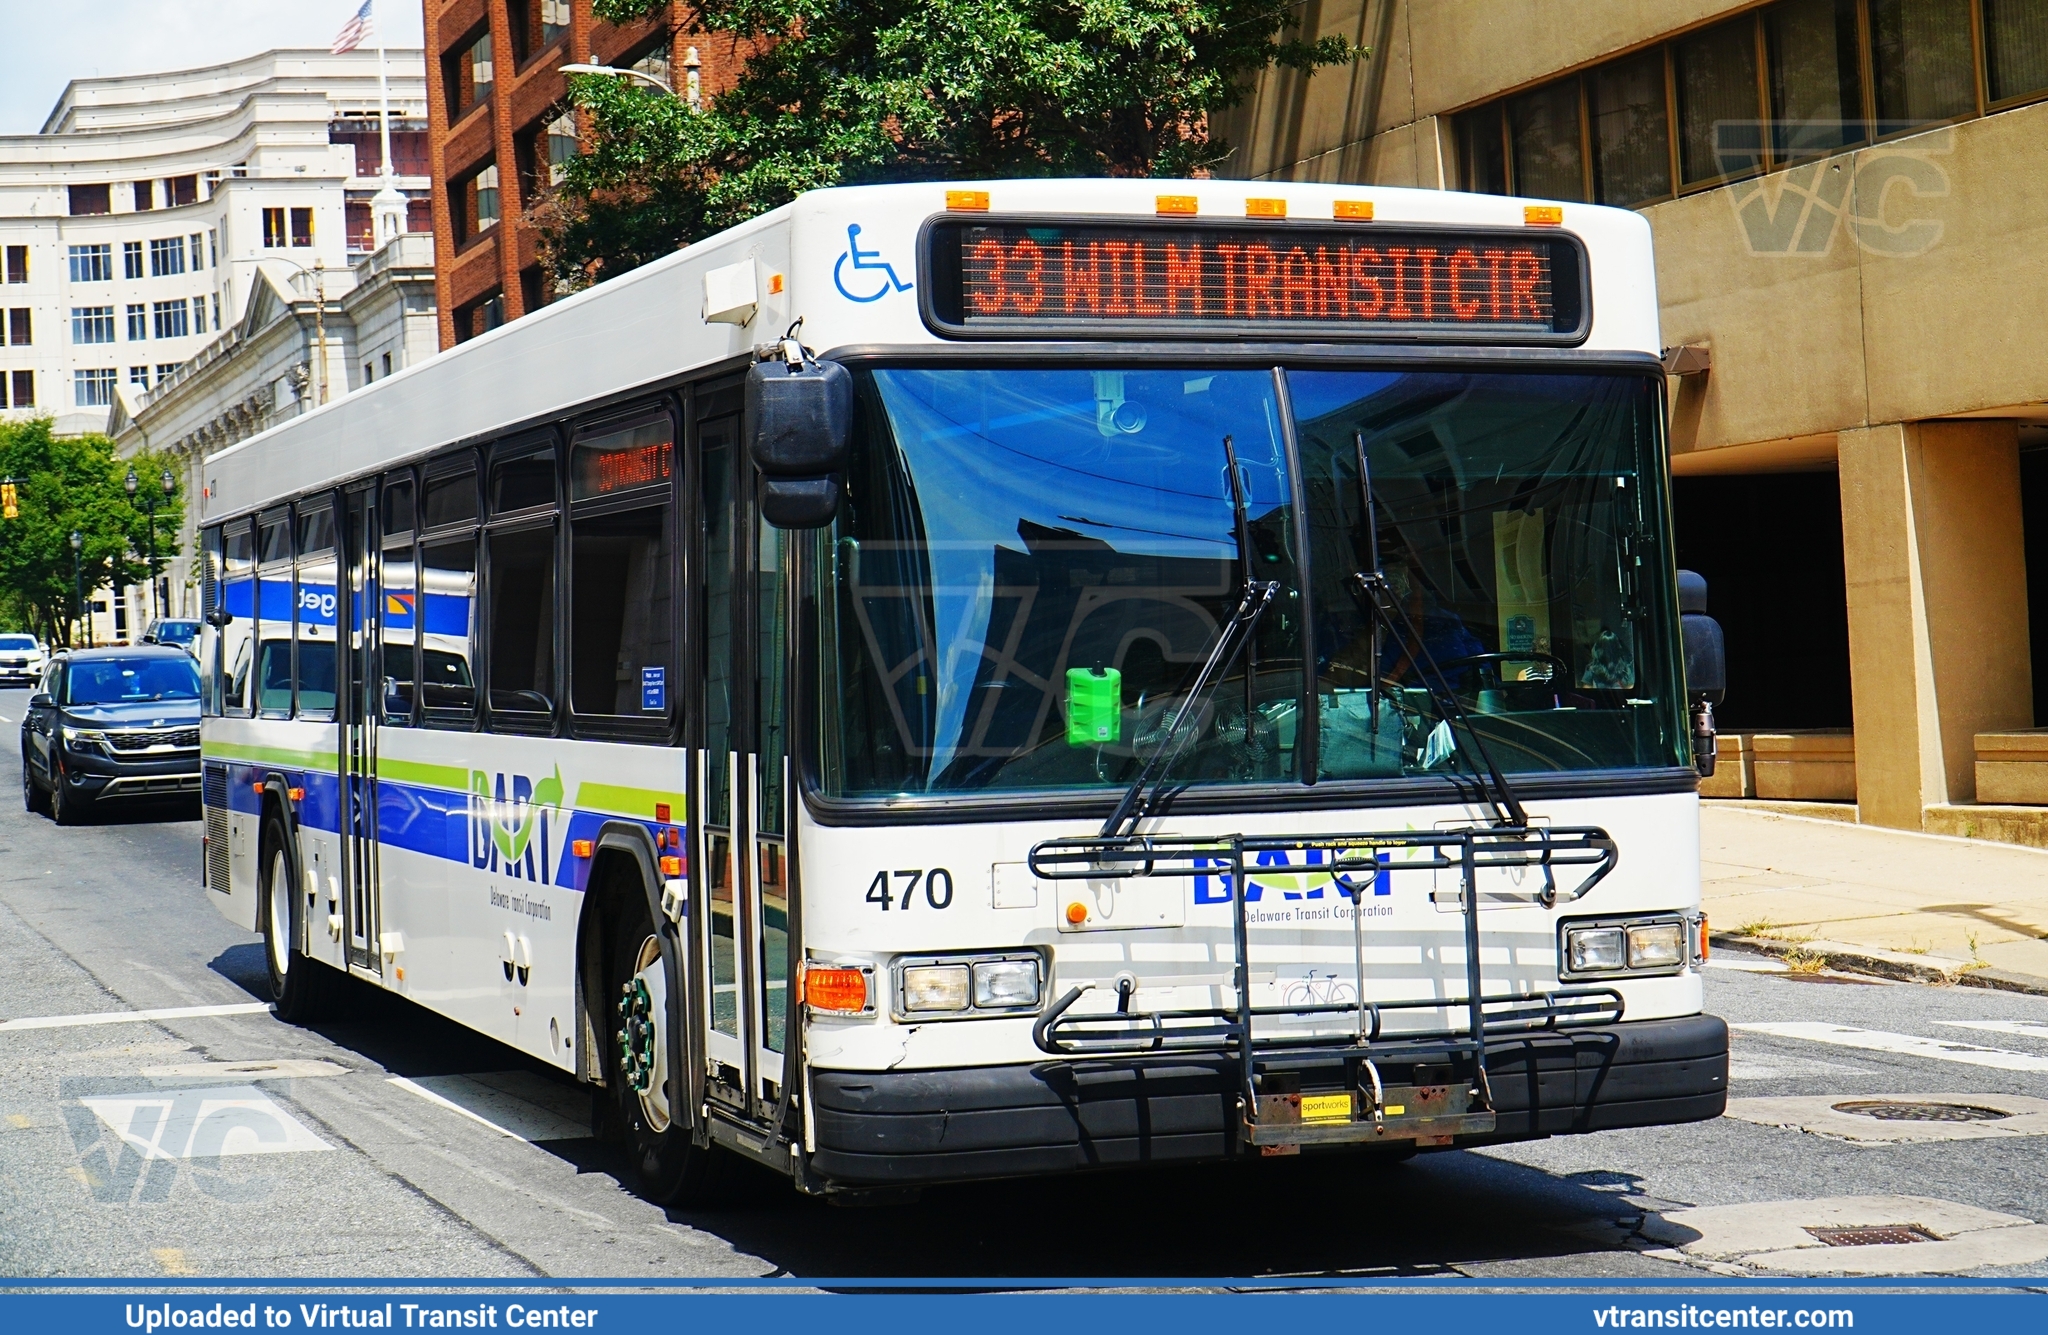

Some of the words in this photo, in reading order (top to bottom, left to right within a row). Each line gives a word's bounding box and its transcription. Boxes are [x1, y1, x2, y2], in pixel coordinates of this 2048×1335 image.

[973, 239, 1043, 313] 33
[1064, 241, 1202, 314] WILM
[1218, 244, 1437, 318] TRANSIT
[1450, 248, 1541, 319] CTR
[472, 759, 565, 886] DART
[866, 868, 952, 910] 470
[1295, 906, 1330, 921] Transit
[1302, 1100, 1349, 1112] sportworks
